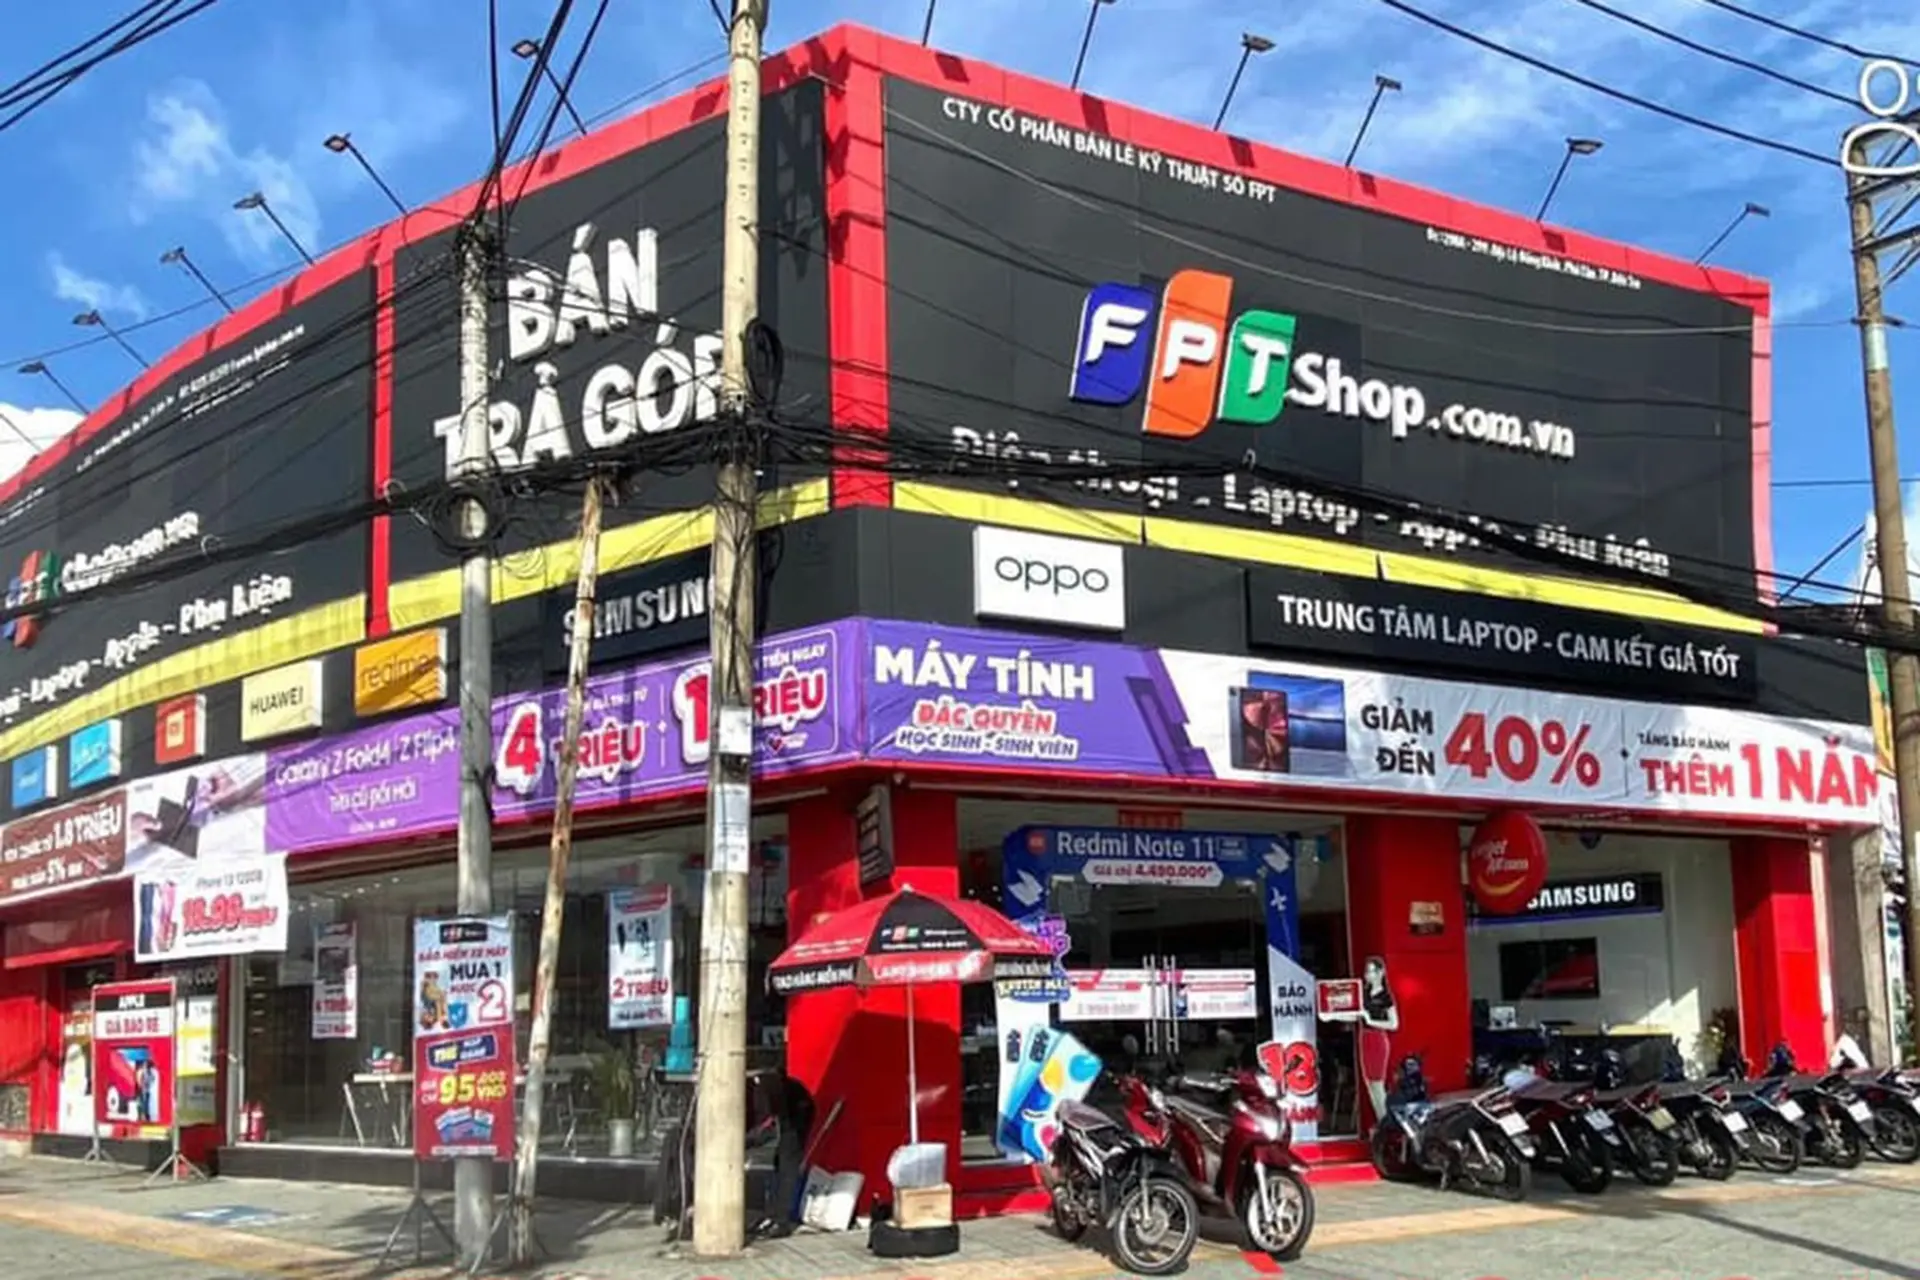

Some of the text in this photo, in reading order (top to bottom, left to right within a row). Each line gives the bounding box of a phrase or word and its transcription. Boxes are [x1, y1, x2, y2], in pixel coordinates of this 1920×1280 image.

[943, 96, 1277, 203] CTY CỔ PHẦN BÁN LẺ KỸ THUẬT SỐ FPT
[507, 222, 659, 360] BÁN
[433, 361, 574, 485] TRẢ
[1290, 352, 1576, 458] Shop.com.vn
[563, 574, 715, 646] SMSUN
[1277, 595, 1374, 633] TRUNG
[1379, 603, 1436, 640] TÂM
[1442, 615, 1539, 653] LAPTOP
[1557, 632, 1610, 664] CAM
[1614, 634, 1656, 670] KẾT
[1659, 641, 1698, 674] GIÁ
[1699, 645, 1741, 679] TỐT
[360, 655, 430, 693] realme
[874, 640, 1095, 700] MÁY TÍNH
[249, 685, 304, 716] HUAWEI
[753, 668, 826, 722] RIỆU
[972, 704, 1054, 733] QUYỀN
[1361, 697, 1434, 734] GIẢM
[332, 750, 344, 774] Z
[503, 709, 543, 778] 4
[899, 731, 937, 751] HỌC
[940, 732, 983, 750] SINH
[994, 735, 1035, 754] SINH
[1037, 736, 1076, 757] VIÊN
[1376, 738, 1436, 776] ĐẾN
[1444, 712, 1601, 787] 40%
[1639, 753, 1735, 798] THÊM
[1739, 744, 1765, 798] 1
[1057, 831, 1128, 857] Redmi
[1134, 832, 1186, 859] Note
[1193, 836, 1215, 859] 11
[1526, 881, 1637, 909] SAMSUNG
[449, 961, 502, 981] MUA 1
[612, 977, 626, 998] 2
[1277, 979, 1307, 998] BẢO
[477, 978, 508, 1022] 2
[1274, 1003, 1313, 1019] HÀNH
[439, 1073, 476, 1105] 95
